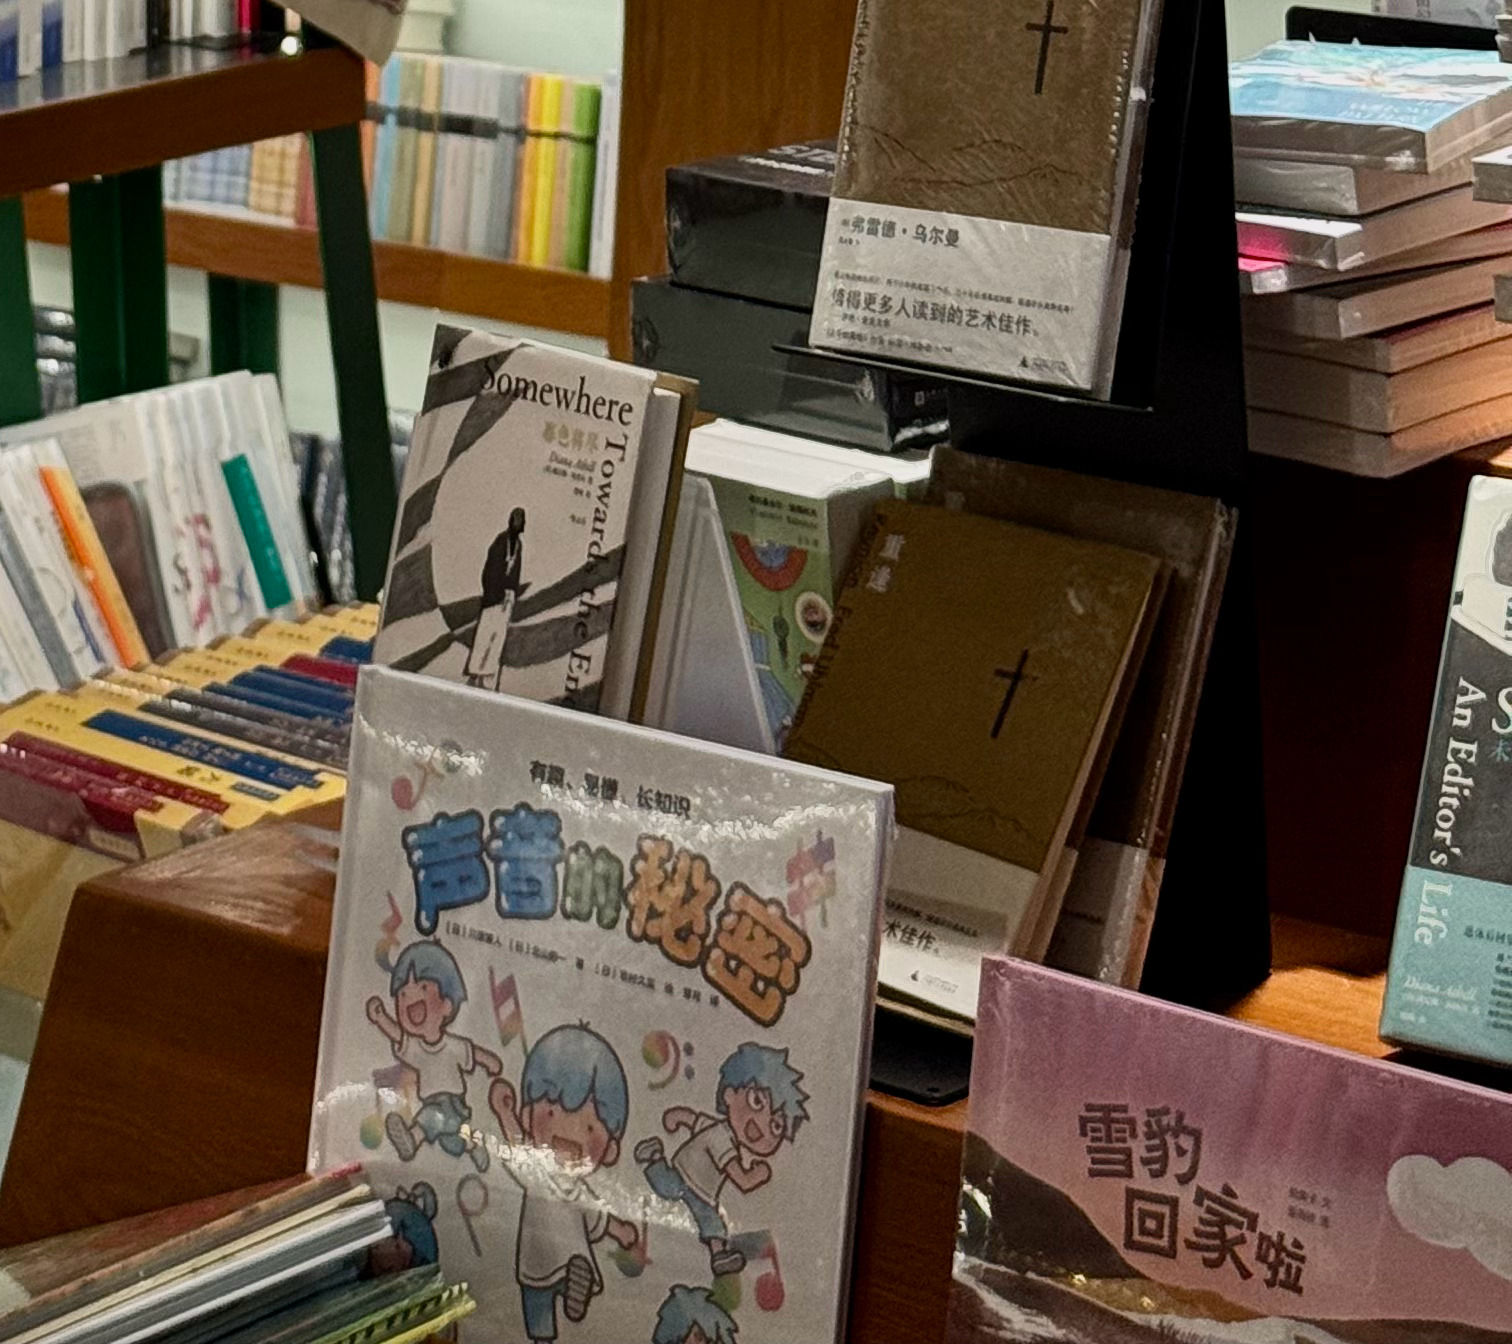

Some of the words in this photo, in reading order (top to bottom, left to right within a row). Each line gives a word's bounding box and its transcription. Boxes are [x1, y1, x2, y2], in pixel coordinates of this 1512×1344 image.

[481, 360, 635, 426] Somewhere
[563, 651, 592, 700] En
[1452, 675, 1487, 728] An
[1429, 736, 1479, 869] Editor's
[401, 802, 813, 1028] 声音的秘密
[1413, 879, 1454, 945] Life
[1077, 1100, 1204, 1187] 雪豹
[1122, 1182, 1307, 1295] 回家啦
